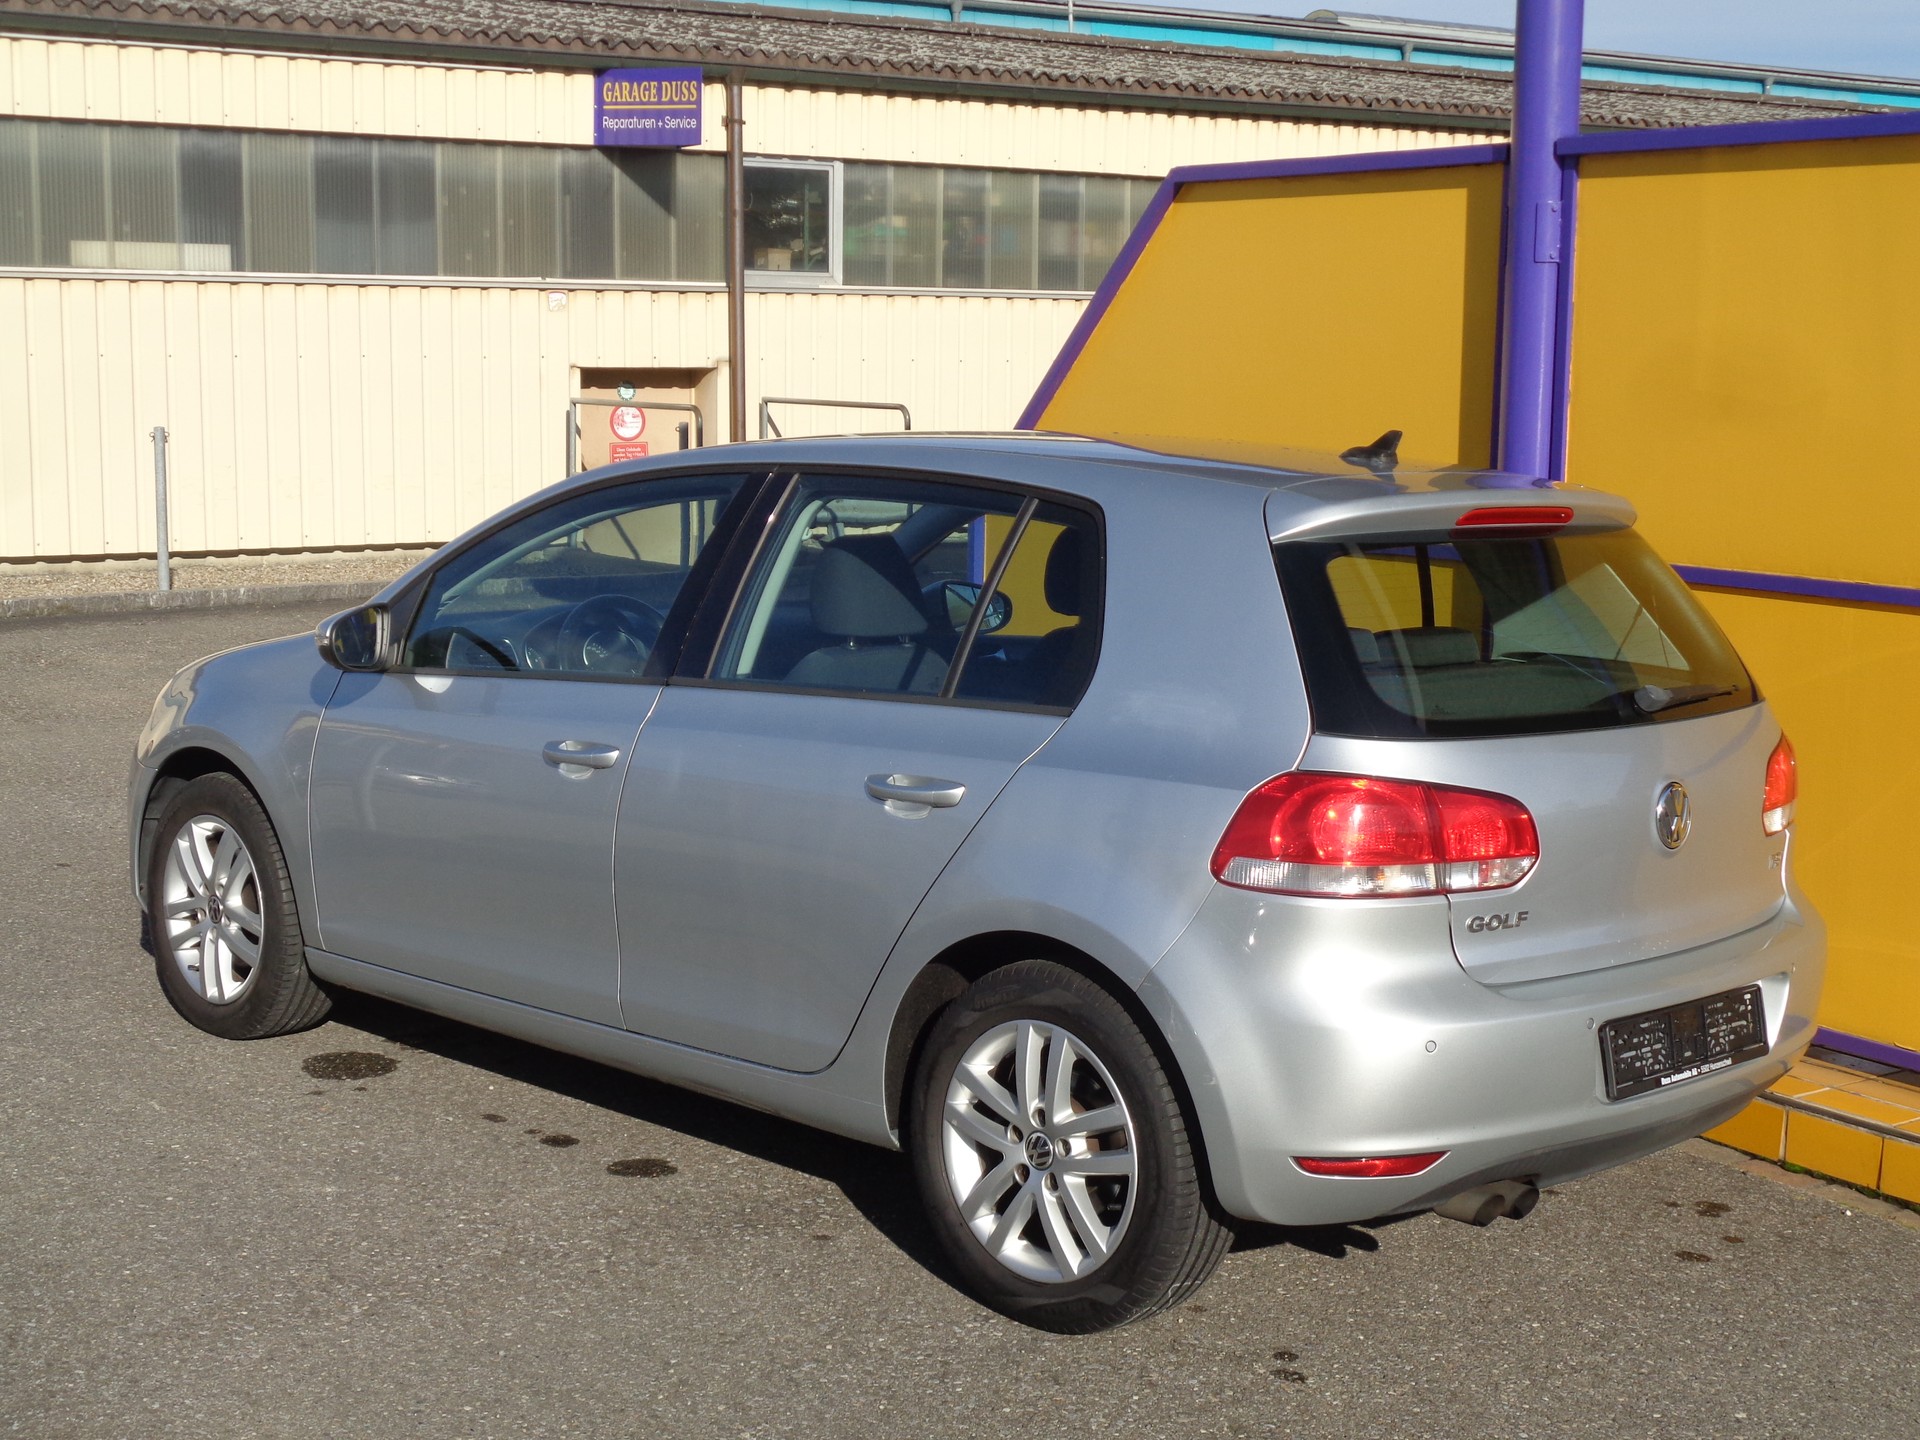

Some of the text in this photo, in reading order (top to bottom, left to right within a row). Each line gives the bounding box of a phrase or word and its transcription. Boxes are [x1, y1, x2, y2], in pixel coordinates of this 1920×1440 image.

[603, 81, 697, 102] GARAGE DUSS
[602, 116, 656, 131] Reparaturen
[664, 116, 697, 129] Service
[1465, 910, 1529, 933] GOLF
